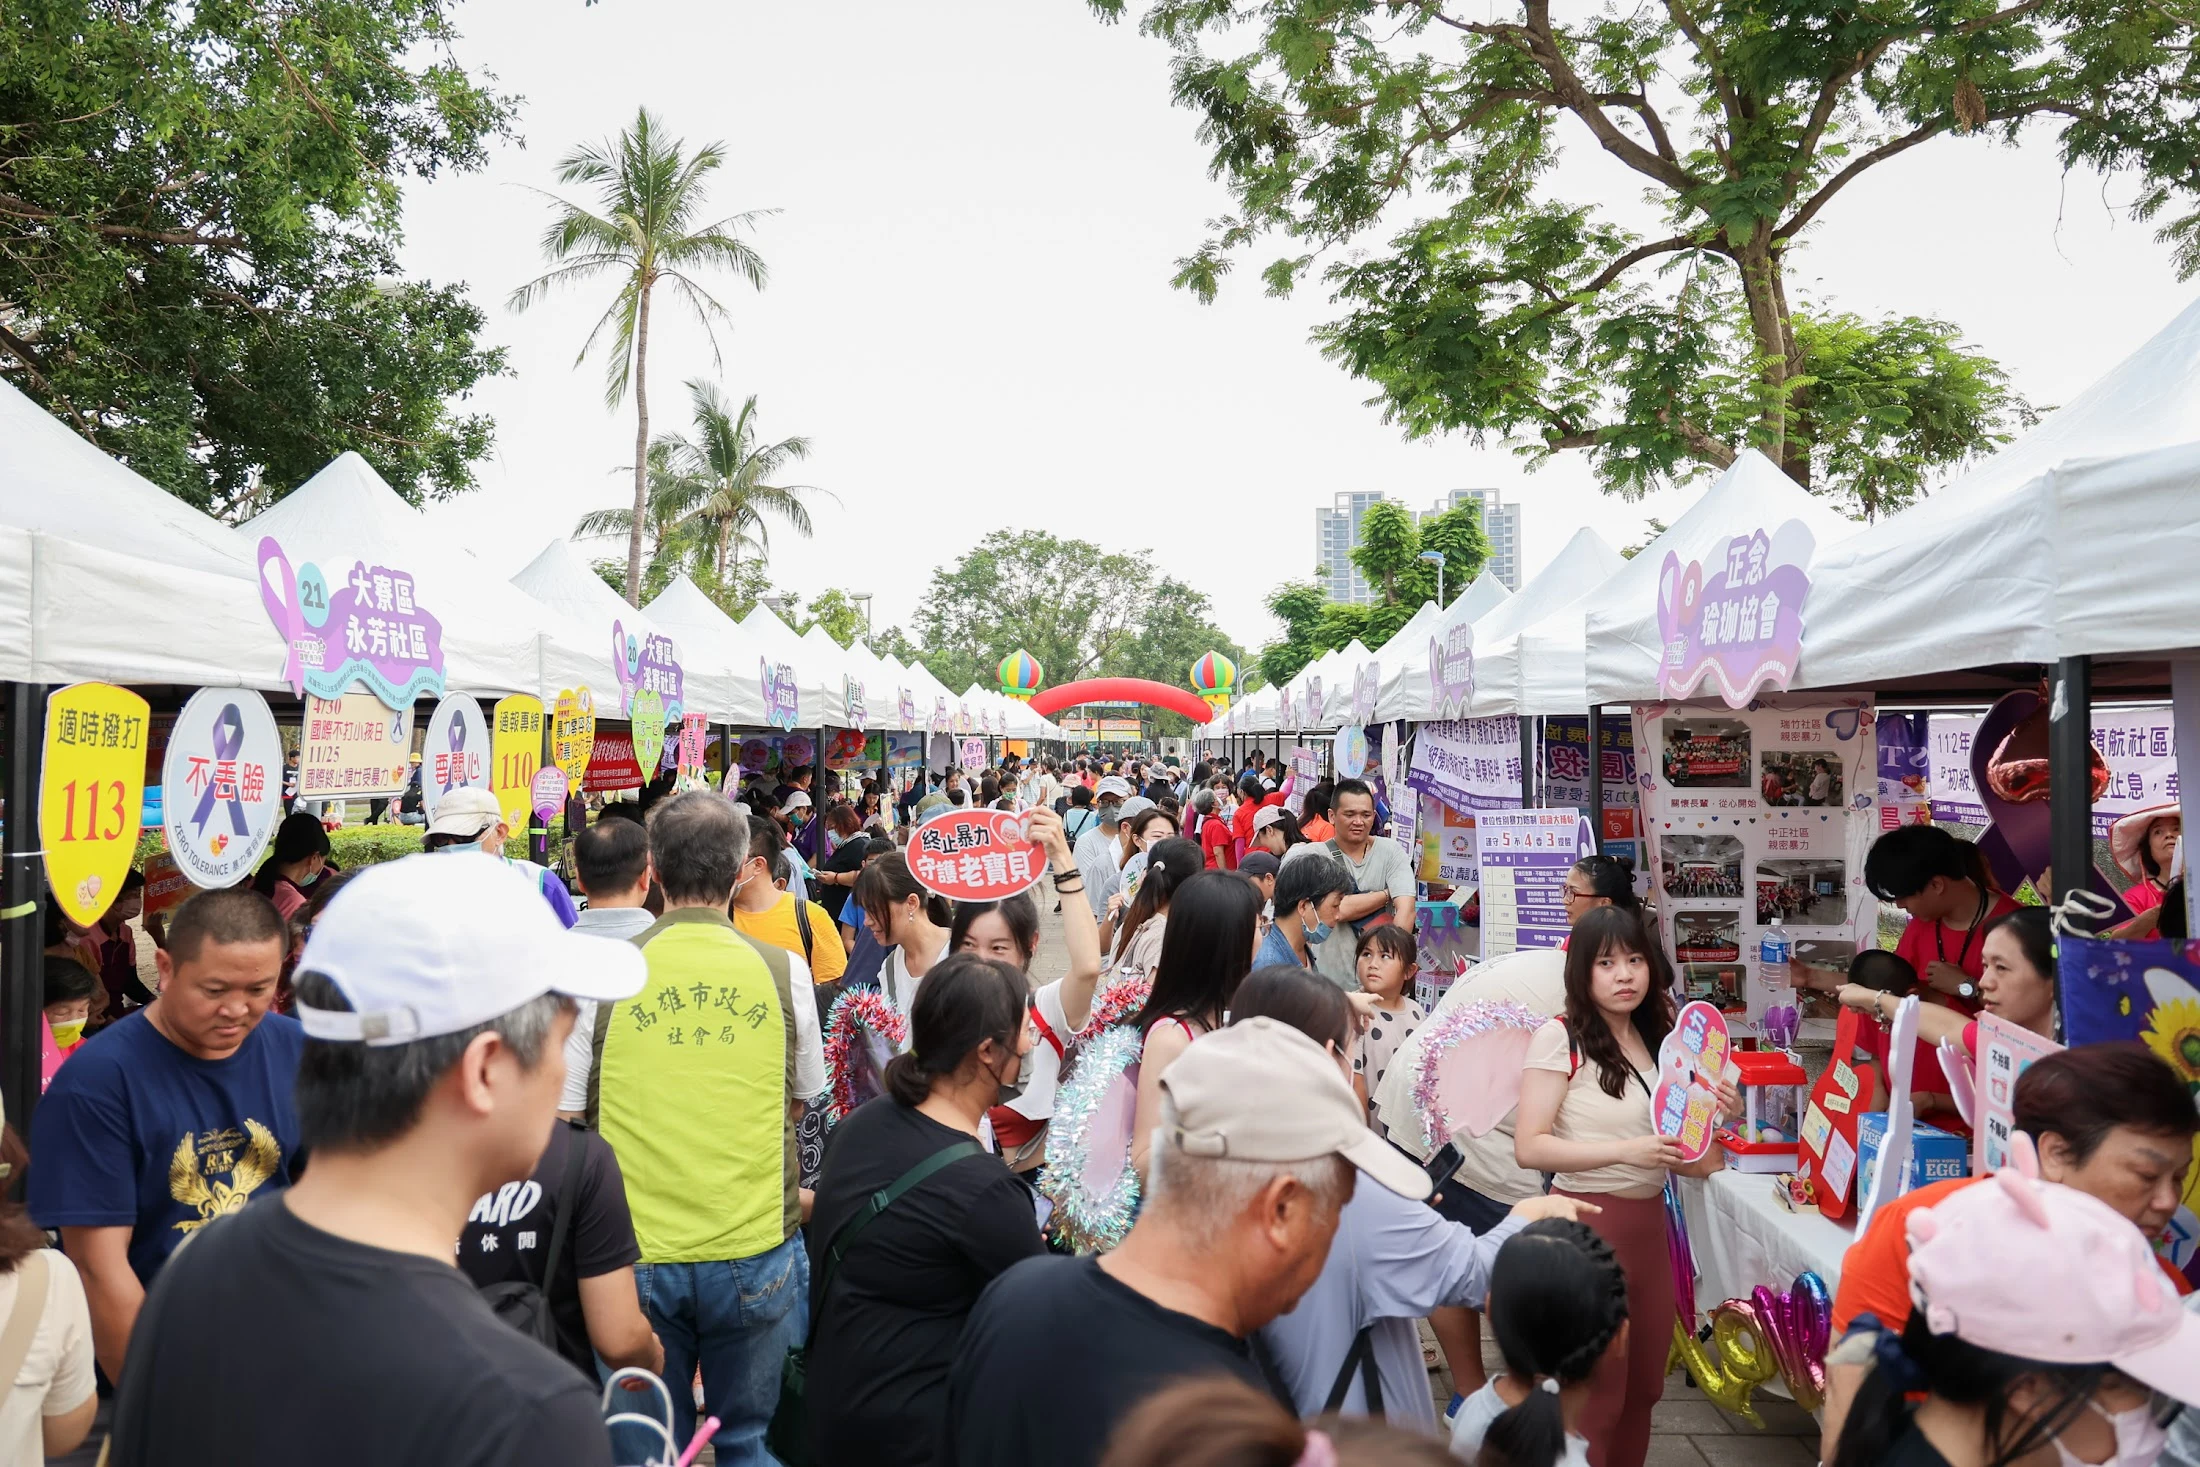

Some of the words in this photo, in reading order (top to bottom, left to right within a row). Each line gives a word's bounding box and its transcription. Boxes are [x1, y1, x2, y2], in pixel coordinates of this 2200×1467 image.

[1725, 539, 1766, 589] 正念
[302, 580, 325, 609] 21
[352, 570, 415, 615] 大寮區
[1685, 579, 1695, 606] 8
[1700, 591, 1780, 646] 瑜珈協會
[346, 613, 429, 660] 永芳社區
[628, 646, 636, 663] 20
[647, 637, 673, 666] 大寮區
[313, 698, 342, 714] 4/30
[57, 708, 141, 749] 適時撥打
[310, 720, 383, 741] 國際不打小孩日
[499, 711, 540, 732] 通報專線
[1781, 719, 1821, 730] 瑞竹社區
[1781, 731, 1821, 742] 親密暴力
[1938, 731, 1971, 756] 112年
[2090, 727, 2177, 757] 領航社區
[309, 746, 340, 762] 11/25
[435, 752, 480, 785] 要關心
[186, 757, 265, 802] 不丟臉
[305, 768, 389, 789] 國際終止婦女受暴力
[501, 752, 533, 790] 110
[59, 779, 126, 842] 113
[921, 823, 990, 853] 終止暴力
[1503, 832, 1510, 846] 5
[1524, 834, 1532, 847] 4
[1546, 833, 1554, 846] 3
[1768, 828, 1809, 838] 中正社區
[1768, 840, 1809, 850] 親密暴力
[174, 821, 190, 854] ZERO
[187, 848, 229, 876] TOLERANCE
[232, 827, 265, 873] 暴力零容忍
[916, 851, 1032, 887] 守護老寶貝
[629, 981, 769, 1032] 高雄市政府
[667, 1025, 735, 1046] 社會局
[1702, 1026, 1726, 1072] 自在
[1660, 1083, 1687, 1138] 遠離
[1682, 1009, 1708, 1054] 暴力
[1863, 1130, 1882, 1147] EGG
[1925, 1164, 1961, 1177] EGG
